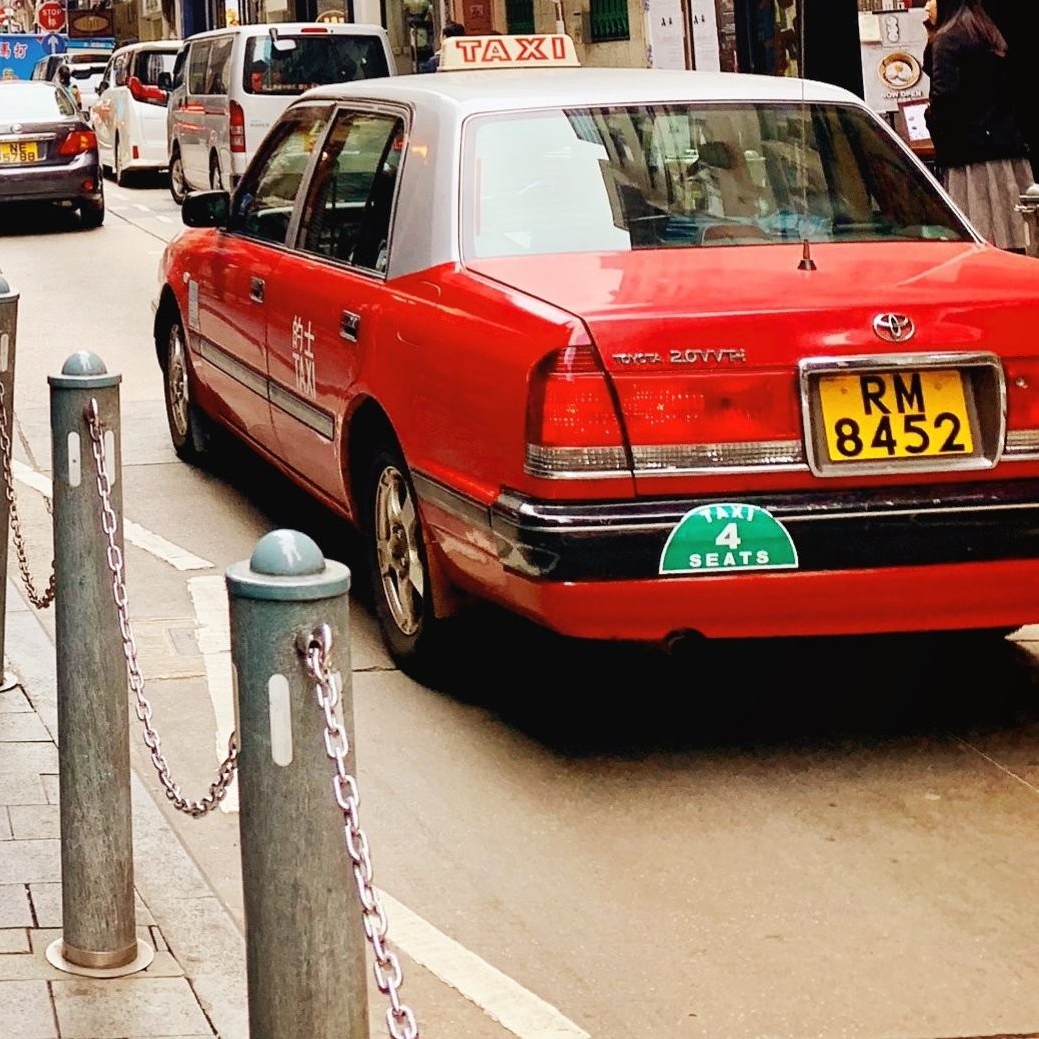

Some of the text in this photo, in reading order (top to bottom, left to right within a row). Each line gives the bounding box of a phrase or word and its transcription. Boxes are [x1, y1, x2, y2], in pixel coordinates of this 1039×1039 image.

[455, 37, 566, 63] TAXI
[2, 152, 36, 162] 5788
[10, 142, 28, 153] NE
[292, 314, 315, 360] 的士
[292, 352, 316, 400] TAXI
[860, 373, 926, 416] RM
[834, 412, 966, 457] 8452
[700, 505, 755, 523] TAXI
[715, 522, 742, 550] 4
[689, 550, 770, 568] SEATS
